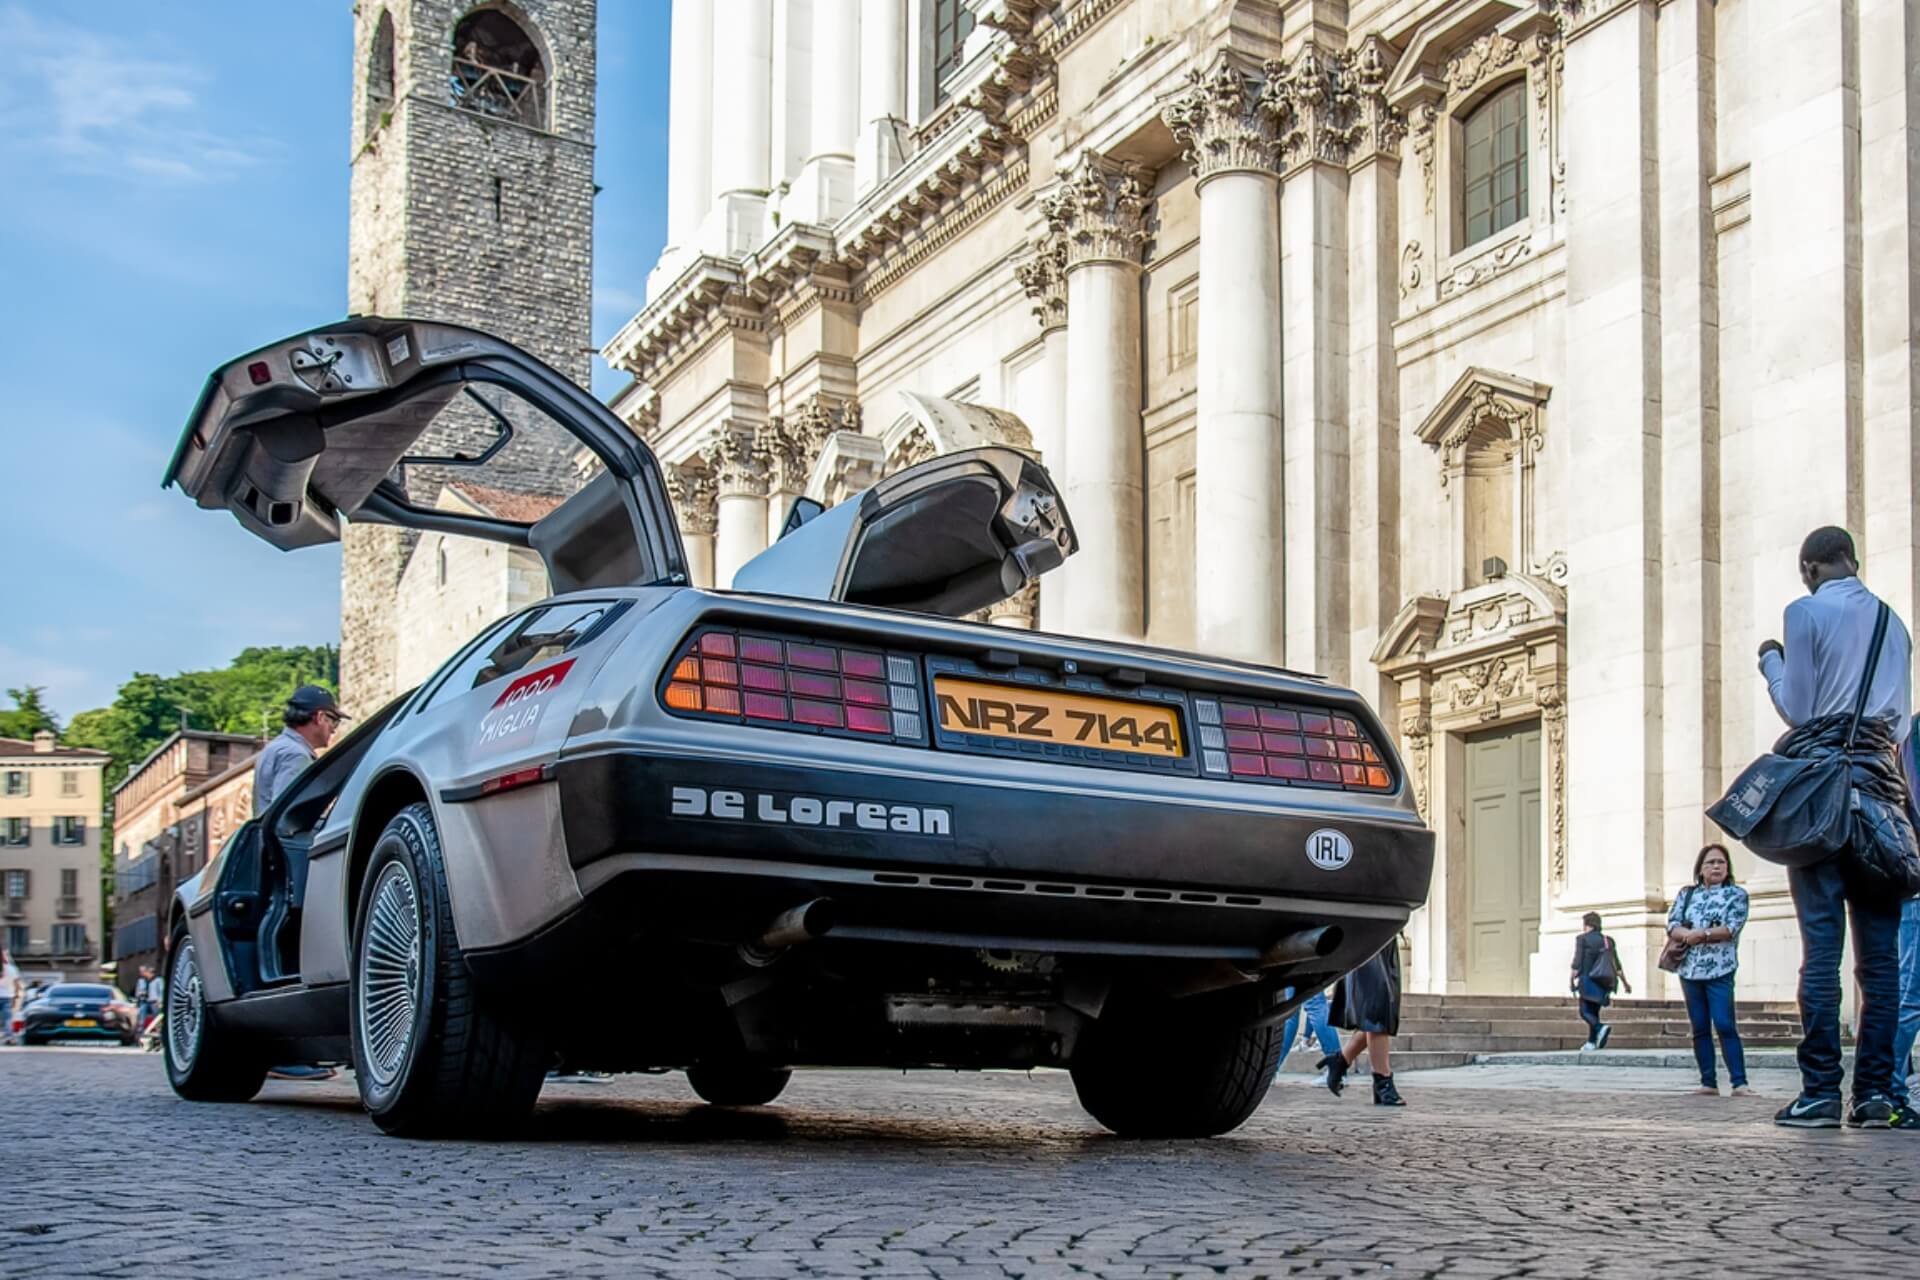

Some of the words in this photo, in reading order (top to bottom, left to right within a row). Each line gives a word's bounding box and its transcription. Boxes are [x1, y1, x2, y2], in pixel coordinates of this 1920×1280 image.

[502, 674, 555, 710] 1000
[480, 704, 540, 744] MIGLIA
[937, 694, 1053, 737] NRZ
[1065, 709, 1177, 751] 7144
[1315, 836, 1344, 861] IRL
